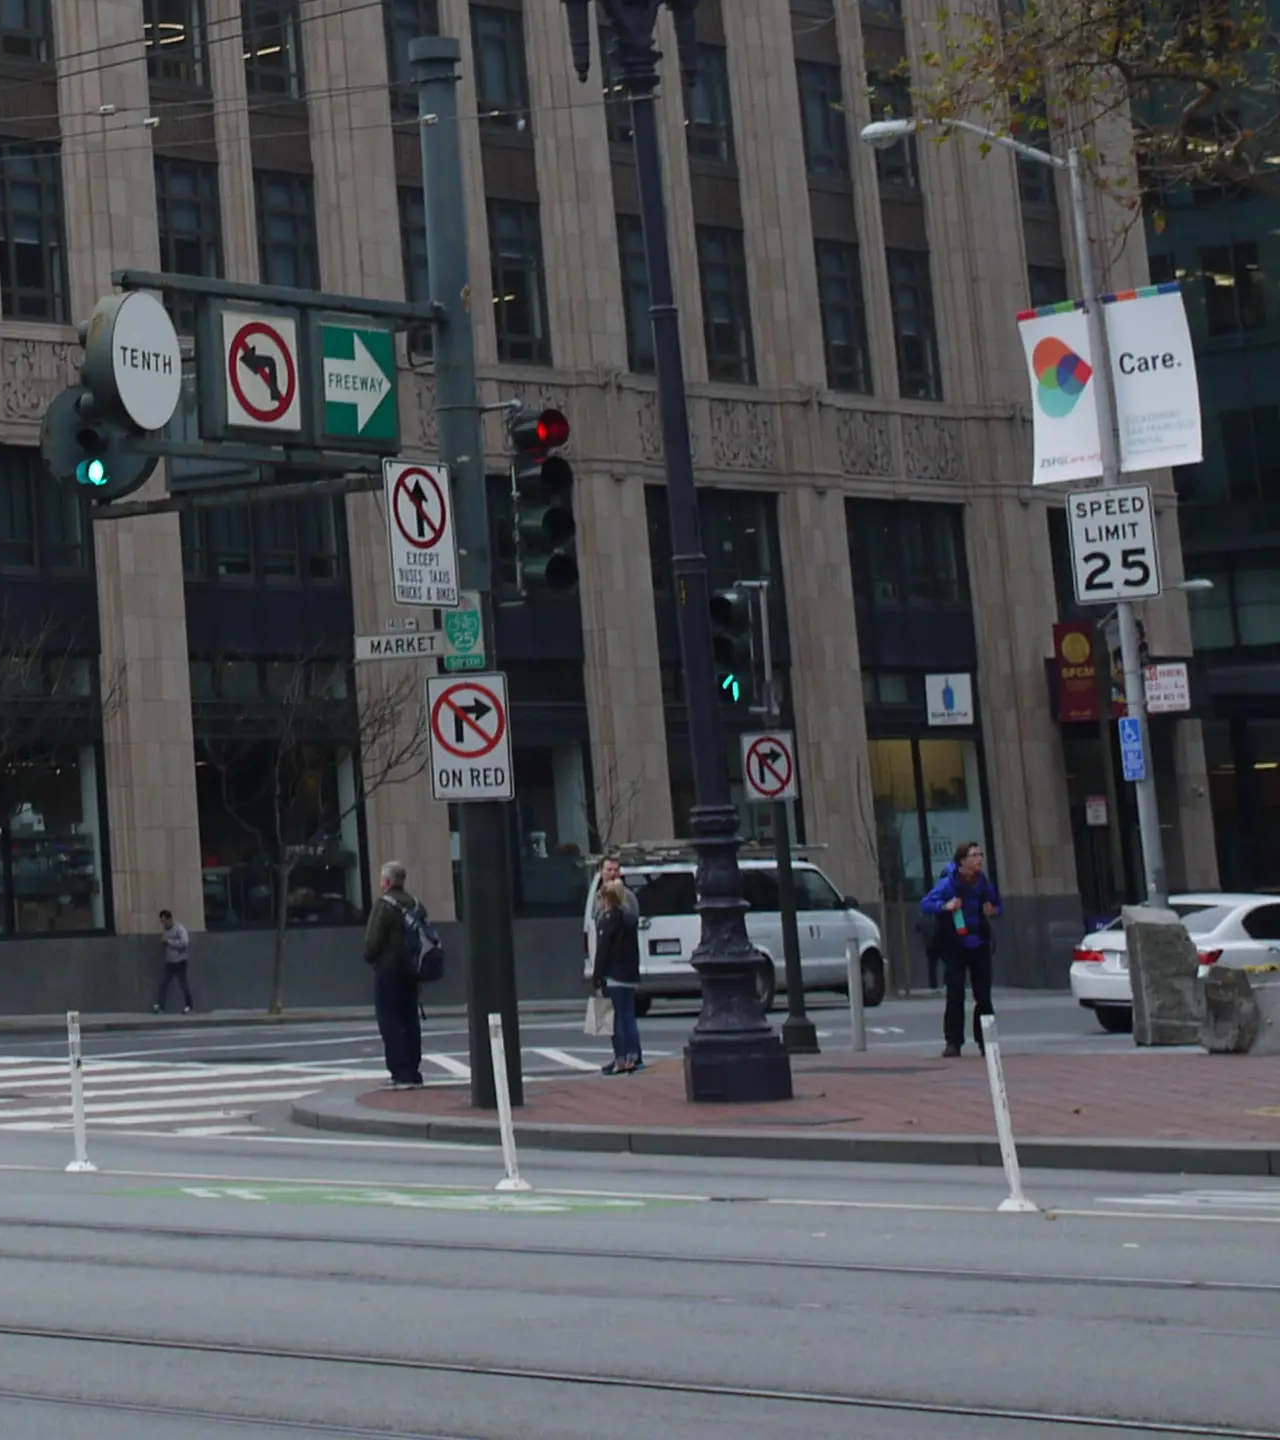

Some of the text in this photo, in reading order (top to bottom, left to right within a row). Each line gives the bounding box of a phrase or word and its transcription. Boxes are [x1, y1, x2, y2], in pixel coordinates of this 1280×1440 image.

[120, 345, 172, 375] TENTH
[1119, 351, 1182, 375] Care.
[328, 371, 384, 393] FREEWAY
[1076, 497, 1144, 518] SPEED
[1085, 522, 1138, 543] LIMIT
[406, 551, 439, 567] EXCEPT
[1082, 547, 1150, 592] 25
[370, 636, 436, 655] MARKET
[439, 767, 505, 788] ON RED
